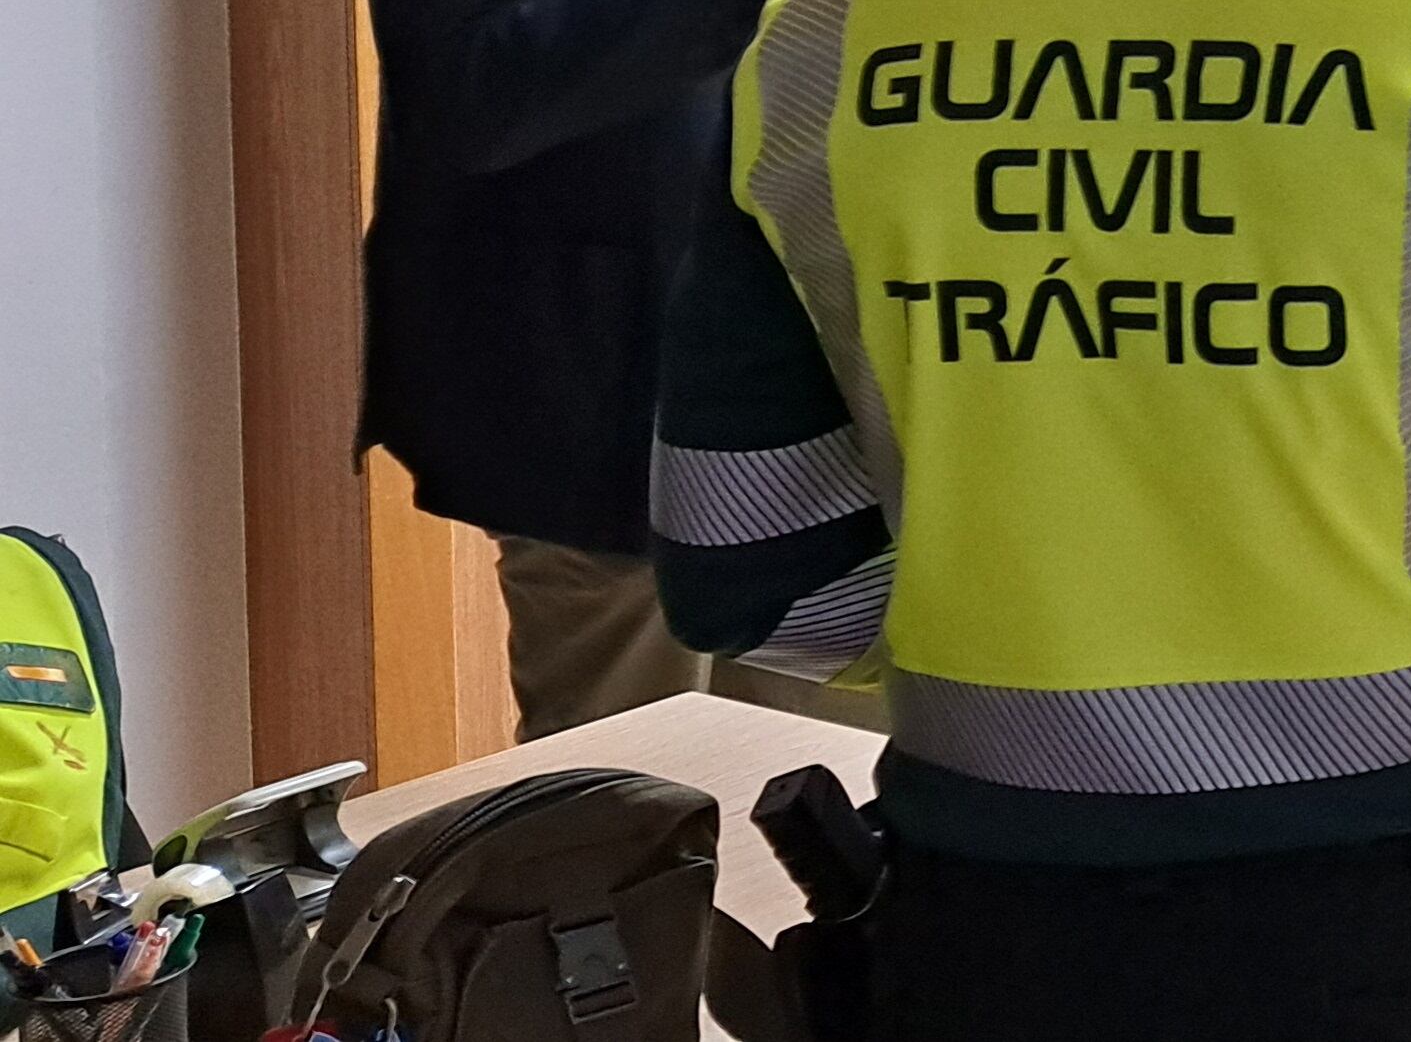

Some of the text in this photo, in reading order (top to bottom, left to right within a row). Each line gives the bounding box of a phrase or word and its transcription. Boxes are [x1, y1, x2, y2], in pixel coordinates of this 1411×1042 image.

[857, 37, 1376, 131] GUARDIA
[974, 148, 1236, 235] CIVIL
[883, 258, 1348, 367] TRÁFICO
